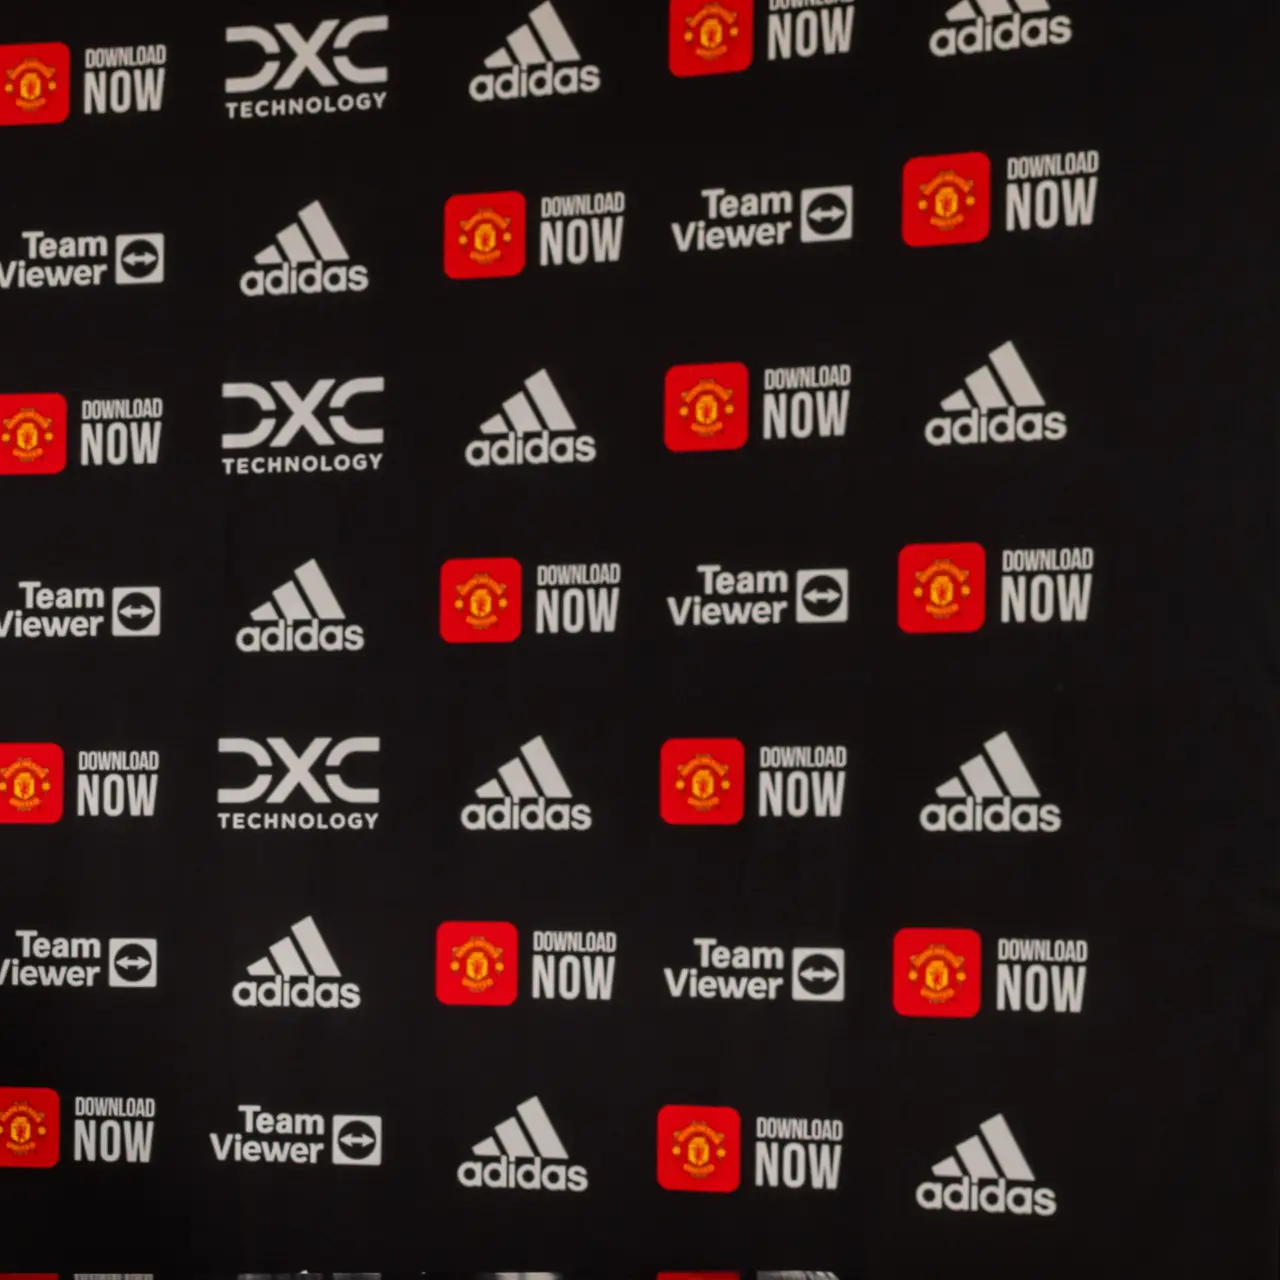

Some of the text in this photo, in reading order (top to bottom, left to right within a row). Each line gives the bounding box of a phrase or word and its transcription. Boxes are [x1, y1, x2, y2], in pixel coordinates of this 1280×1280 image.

[767, 5, 855, 60] NOW
[929, 12, 1073, 58] adidas
[85, 44, 167, 69] DOWNLOAD
[225, 15, 389, 93] DXC
[84, 67, 166, 115] NOW
[468, 61, 601, 102] adidas
[225, 91, 387, 119] TECHNOLOGY
[1007, 150, 1099, 181] DOWNLOAD
[701, 187, 793, 220] Team
[1006, 176, 1098, 231] NOW
[21, 230, 108, 260] Team
[540, 215, 624, 267] NOW
[671, 220, 793, 252] Viewer
[239, 259, 369, 297] adidas
[764, 363, 851, 391] DOWNLOAD
[221, 376, 385, 449] DXC
[763, 389, 850, 440] NOW
[924, 405, 1067, 446] adidas
[80, 420, 162, 466] NOW
[464, 429, 597, 467] adidas
[221, 453, 383, 475] TECHNOLOGY
[537, 562, 621, 587] DOWNLOAD
[1002, 547, 1094, 573] DOWNLOAD
[18, 580, 105, 610] Team
[696, 564, 789, 595] Team
[1001, 573, 1093, 623] NOW
[535, 587, 620, 634] NOW
[667, 595, 788, 626] Viewer
[235, 617, 365, 653] adidas
[78, 750, 160, 771] DOWNLOAD
[217, 736, 380, 804] DXC
[759, 745, 847, 768] DOWNLOAD
[77, 773, 159, 817] NOW
[758, 770, 846, 818] NOW
[217, 812, 379, 830] TECHNOLOGY
[460, 796, 592, 831] adidas
[919, 795, 1062, 833] adidas
[15, 929, 101, 959] Team
[693, 937, 785, 970] Team
[231, 973, 361, 1009] adidas
[531, 954, 616, 1001] NOW
[663, 967, 784, 1000] Viewer
[996, 963, 1087, 1013] NOW
[75, 1096, 156, 1118] DOWNLOAD
[237, 1104, 325, 1136] Team
[74, 1119, 154, 1163] NOW
[209, 1132, 325, 1164] Viewer
[456, 1154, 589, 1192] adidas
[755, 1141, 842, 1190] NOW
[915, 1175, 1057, 1216] adidas
